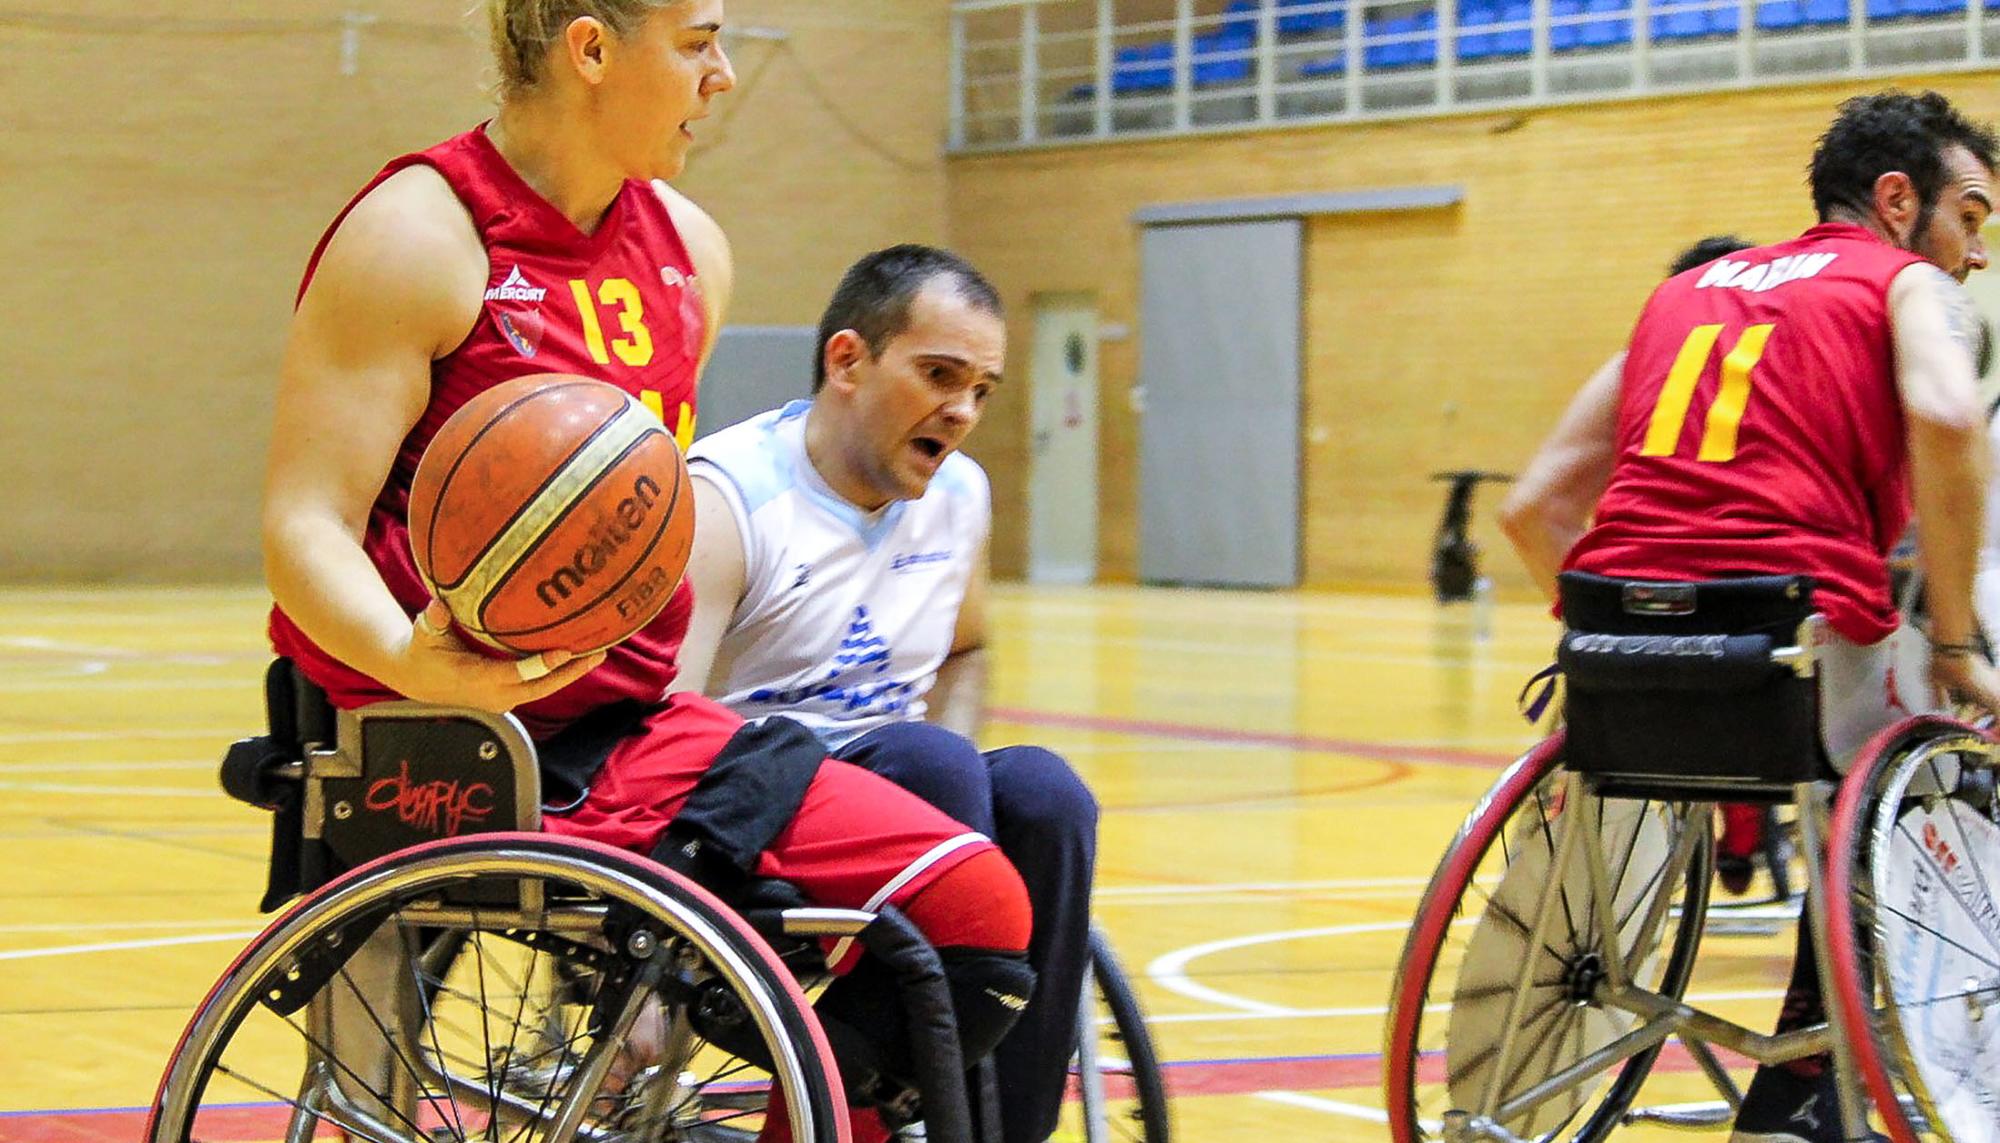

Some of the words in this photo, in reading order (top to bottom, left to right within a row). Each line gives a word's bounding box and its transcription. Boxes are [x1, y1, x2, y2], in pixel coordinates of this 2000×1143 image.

[484, 286, 548, 302] MERCURY
[567, 277, 654, 367] 13
[1638, 323, 1776, 462] 11
[535, 474, 661, 609] molten
